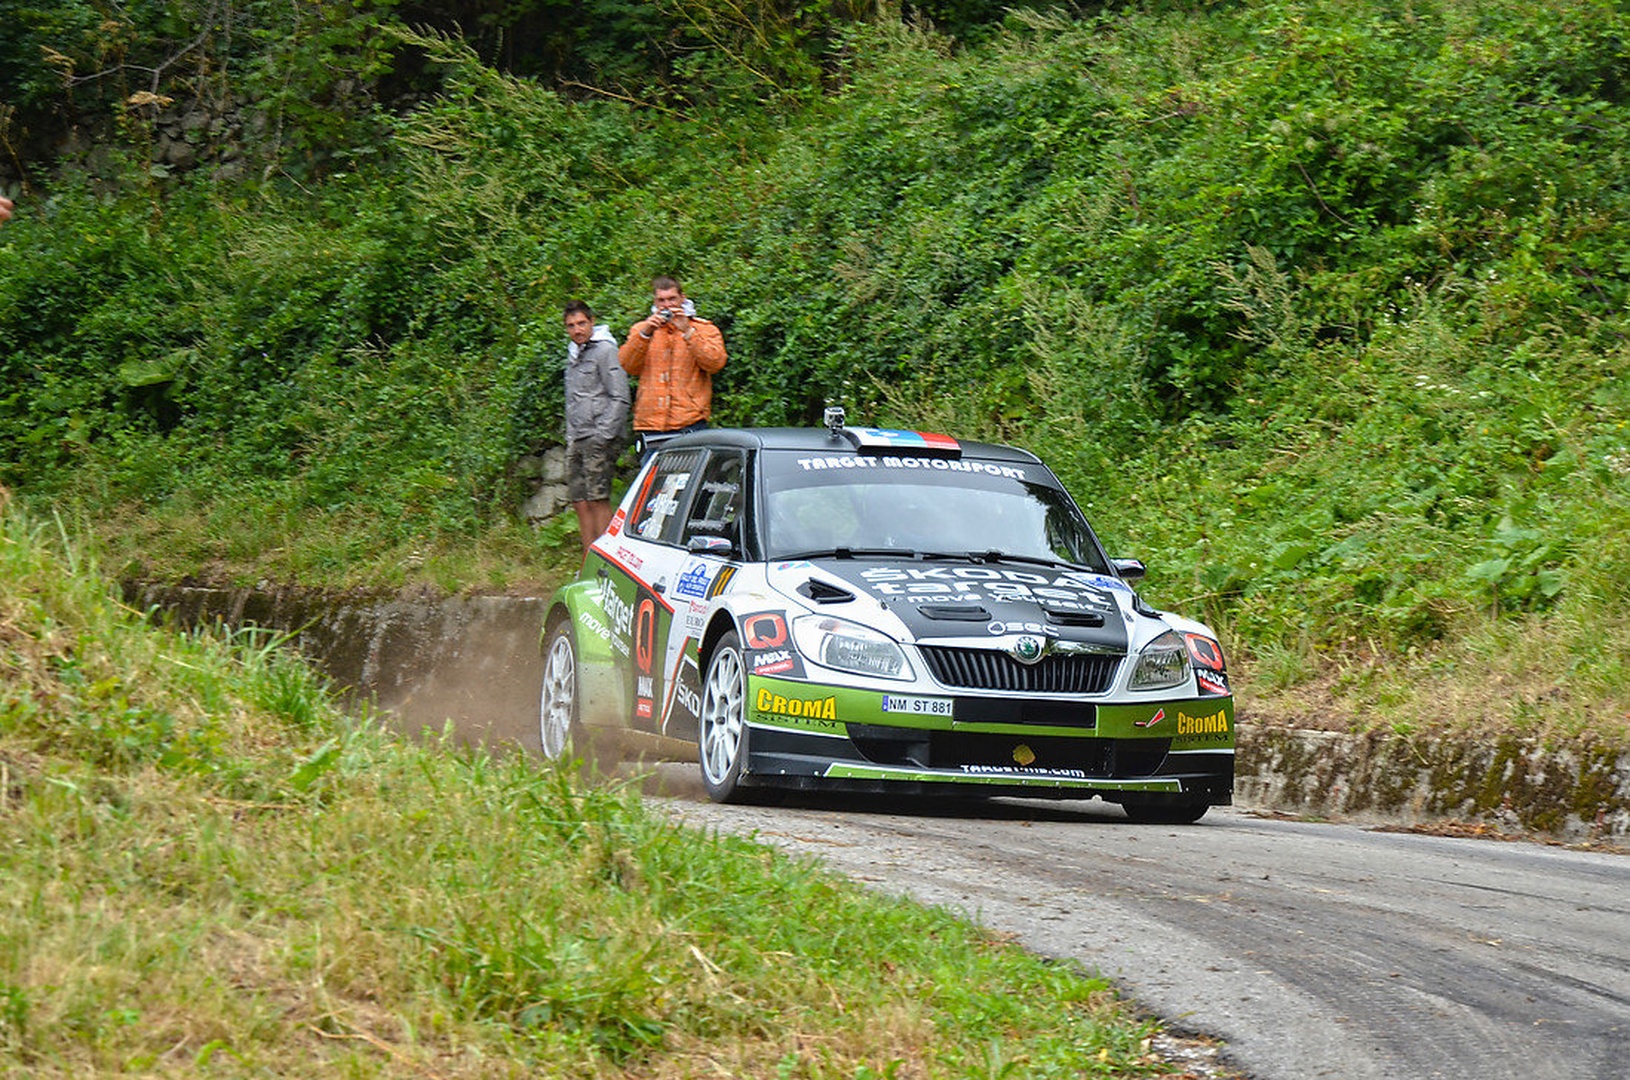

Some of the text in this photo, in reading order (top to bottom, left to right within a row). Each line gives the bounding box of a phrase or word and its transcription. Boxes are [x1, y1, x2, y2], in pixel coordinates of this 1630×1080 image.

[798, 456, 1026, 480] TARGET MOTORSPORT
[860, 566, 1106, 594] ŠKODA
[871, 580, 1112, 607] target
[907, 593, 982, 603] move
[579, 611, 611, 640] move
[744, 613, 787, 649] Q
[753, 650, 793, 667] MAX
[1185, 633, 1224, 672] Q
[888, 698, 951, 714] NM ST 881
